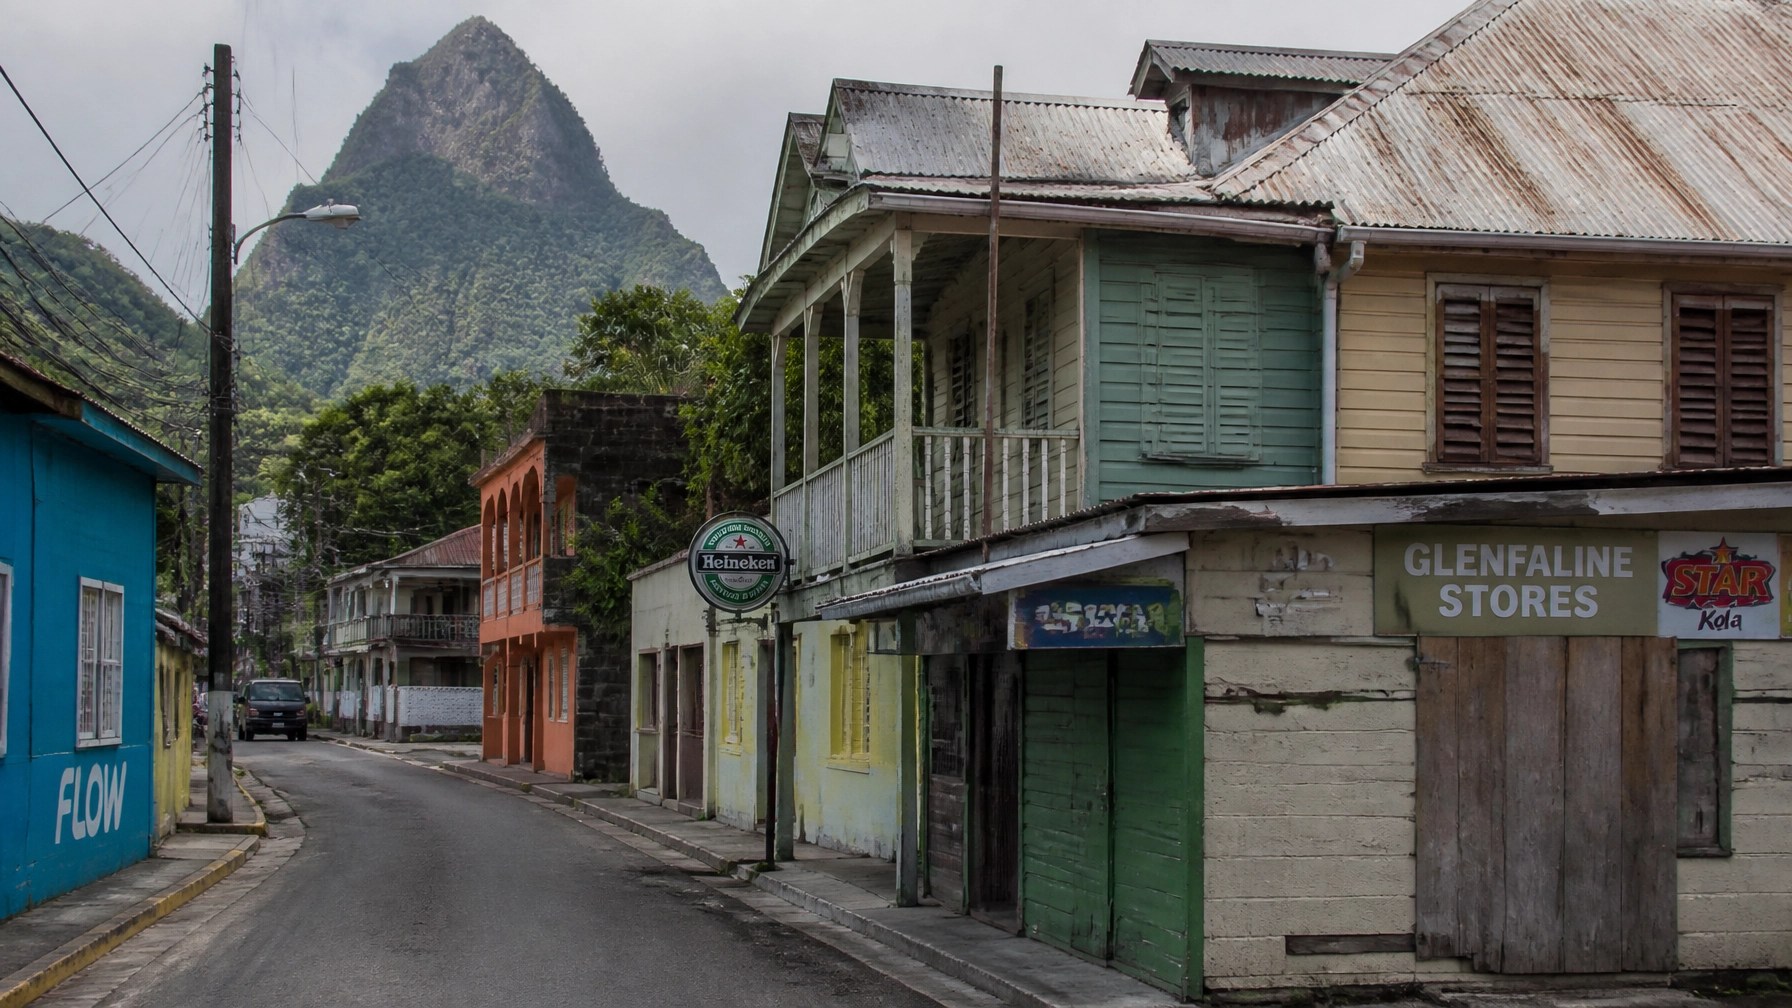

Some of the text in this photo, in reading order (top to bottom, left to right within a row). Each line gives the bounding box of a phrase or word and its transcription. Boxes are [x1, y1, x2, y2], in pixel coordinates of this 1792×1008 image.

[702, 554, 776, 570] Heineken
[1404, 542, 1633, 578] GLENFALINE
[1670, 563, 1771, 597] STAR
[1438, 583, 1599, 618] STORES
[1698, 609, 1742, 632] Kola
[55, 760, 127, 845] FLOW
